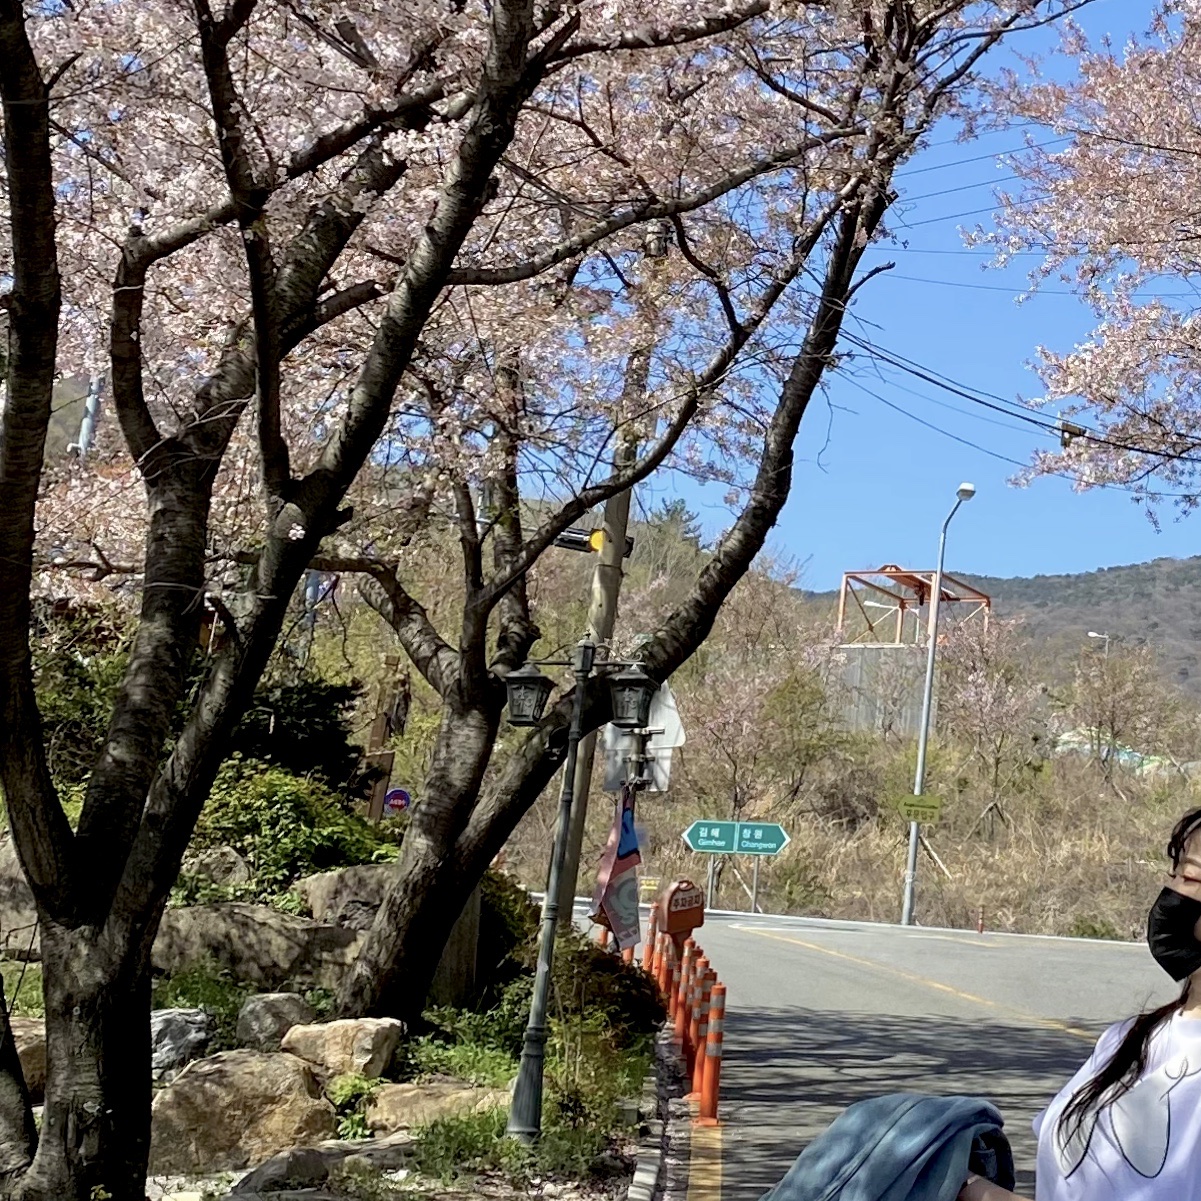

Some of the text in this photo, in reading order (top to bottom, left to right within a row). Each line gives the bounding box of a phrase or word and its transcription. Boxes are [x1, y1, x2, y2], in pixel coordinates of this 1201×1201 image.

[698, 839, 726, 847] Gimhae
[741, 841, 777, 850] Changwon
[672, 894, 700, 909] 주차금지
